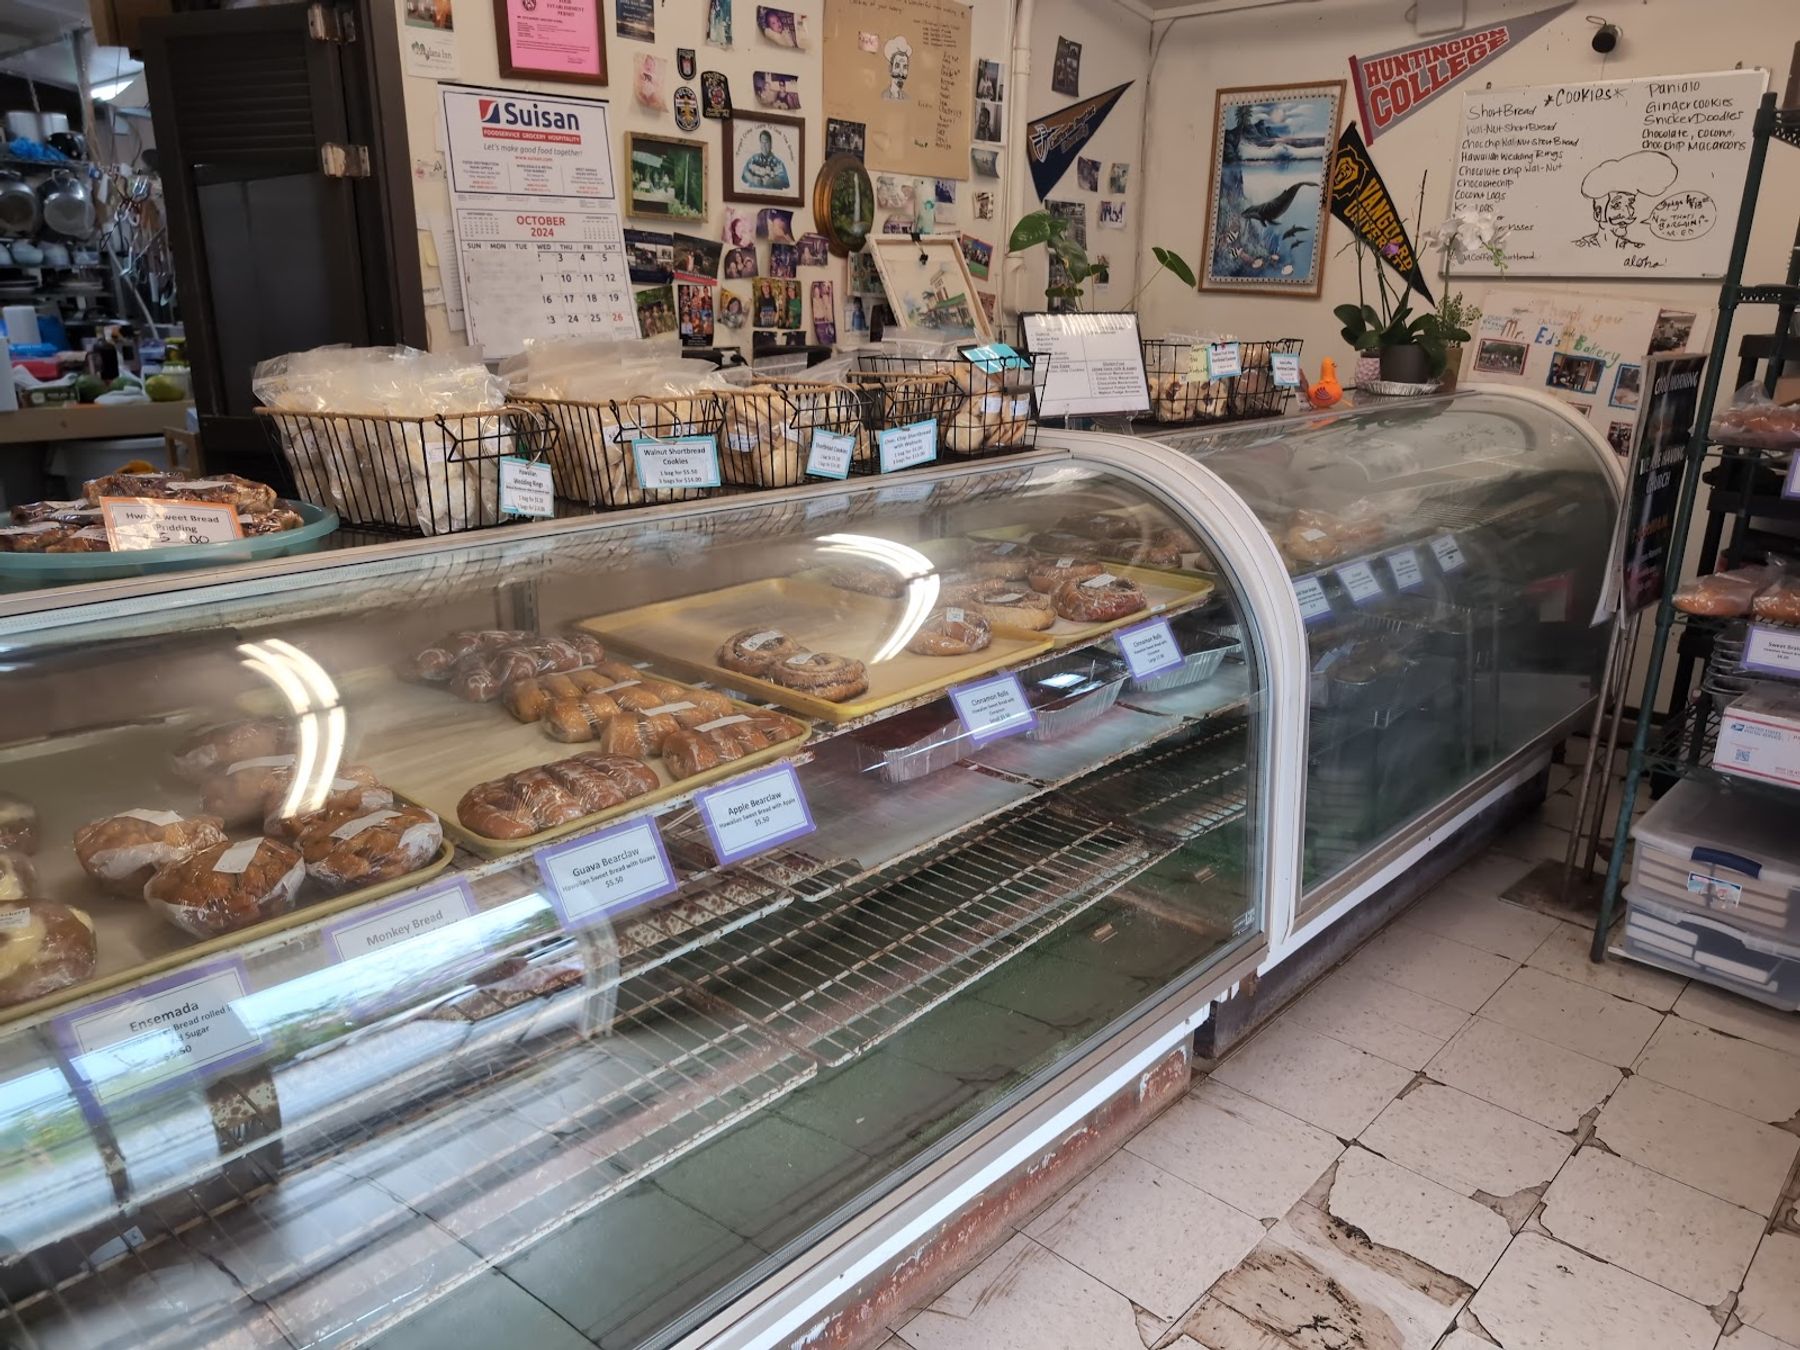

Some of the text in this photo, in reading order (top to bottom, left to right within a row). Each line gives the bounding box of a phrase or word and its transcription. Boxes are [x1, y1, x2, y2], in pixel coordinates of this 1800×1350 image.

[1363, 26, 1508, 90] HUNTINGDON
[1370, 38, 1509, 128] COLLEGE
[504, 102, 580, 131] Suisan
[483, 129, 581, 144] FOODSERVICE GROCERY HOSPITALITY
[483, 143, 500, 151] Let's
[501, 144, 519, 153] make
[520, 145, 537, 155] good
[537, 146, 553, 156] food
[516, 215, 566, 226] OCTOBER
[530, 227, 555, 238] 2024
[558, 253, 608, 262] 3 4 5
[561, 274, 616, 283] 10 11 12
[564, 295, 574, 303] 17
[587, 294, 598, 303] 18
[609, 294, 619, 302] 19
[567, 315, 579, 323] 24
[590, 314, 601, 323] 25
[612, 314, 624, 322] 26
[1500, 318, 1526, 340] Mr.
[1534, 326, 1561, 347] Ed's
[1573, 334, 1622, 368] Bakery
[643, 446, 706, 456] Walnut Shortbread
[189, 513, 220, 523] Bread
[155, 524, 199, 533] Pudding
[1767, 641, 1786, 649] Sweet
[971, 689, 1010, 707] Cinnamon Rolls
[728, 792, 782, 816] Apple Bearclaw
[718, 798, 796, 828] Hawaiian Sweet Bread with Apple
[753, 816, 770, 827] $5.50
[572, 847, 640, 877] Guava Bearclaw
[562, 854, 656, 893] Hawaiian Sweet Bread with Guava
[604, 876, 624, 889] $5.50
[366, 924, 410, 946] Monkey
[411, 909, 444, 930] Bread
[129, 1000, 200, 1033] Ensemada
[173, 1016, 200, 1032] Bread
[200, 1007, 227, 1023] rolled
[184, 1025, 211, 1041] Sugar
